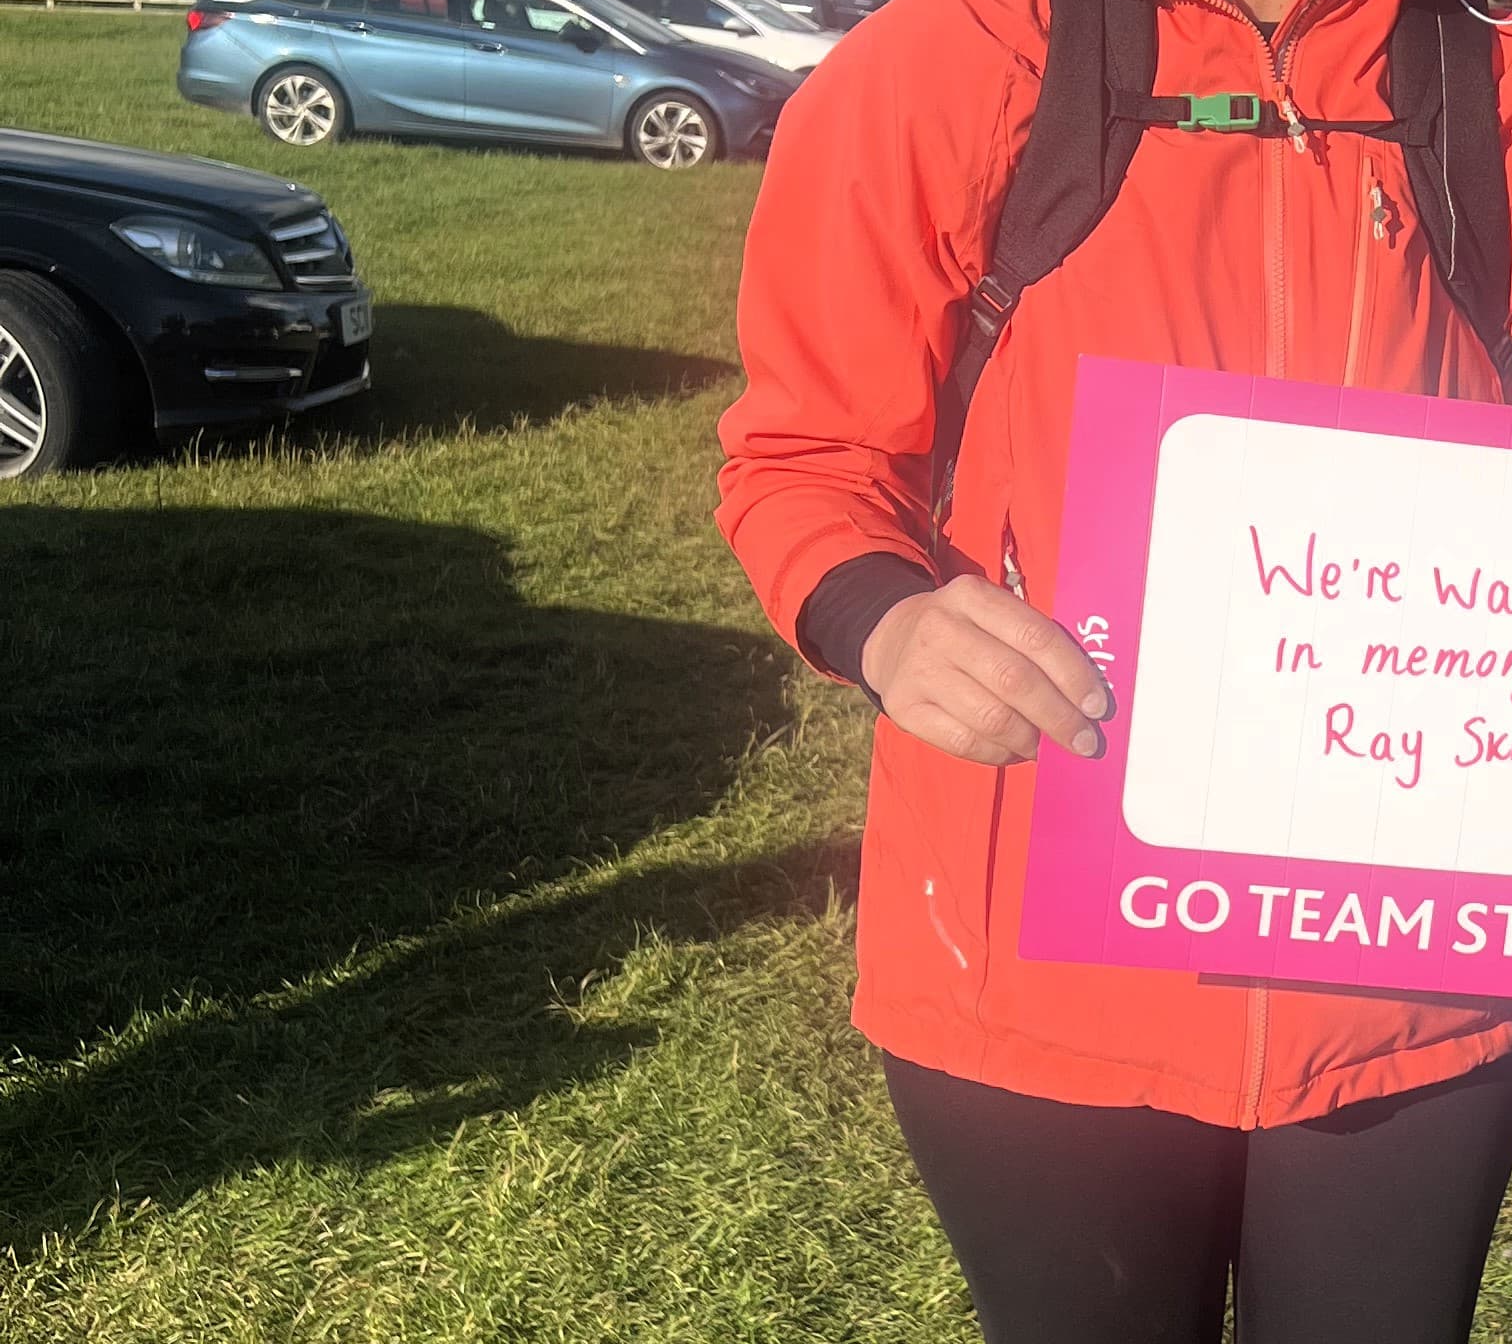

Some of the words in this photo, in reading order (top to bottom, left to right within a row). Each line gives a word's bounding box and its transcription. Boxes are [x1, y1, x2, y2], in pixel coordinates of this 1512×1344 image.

[1249, 525, 1402, 603] We're
[1323, 703, 1424, 790] Ray
[1119, 875, 1231, 933] GO
[1248, 884, 1435, 951] TEAM
